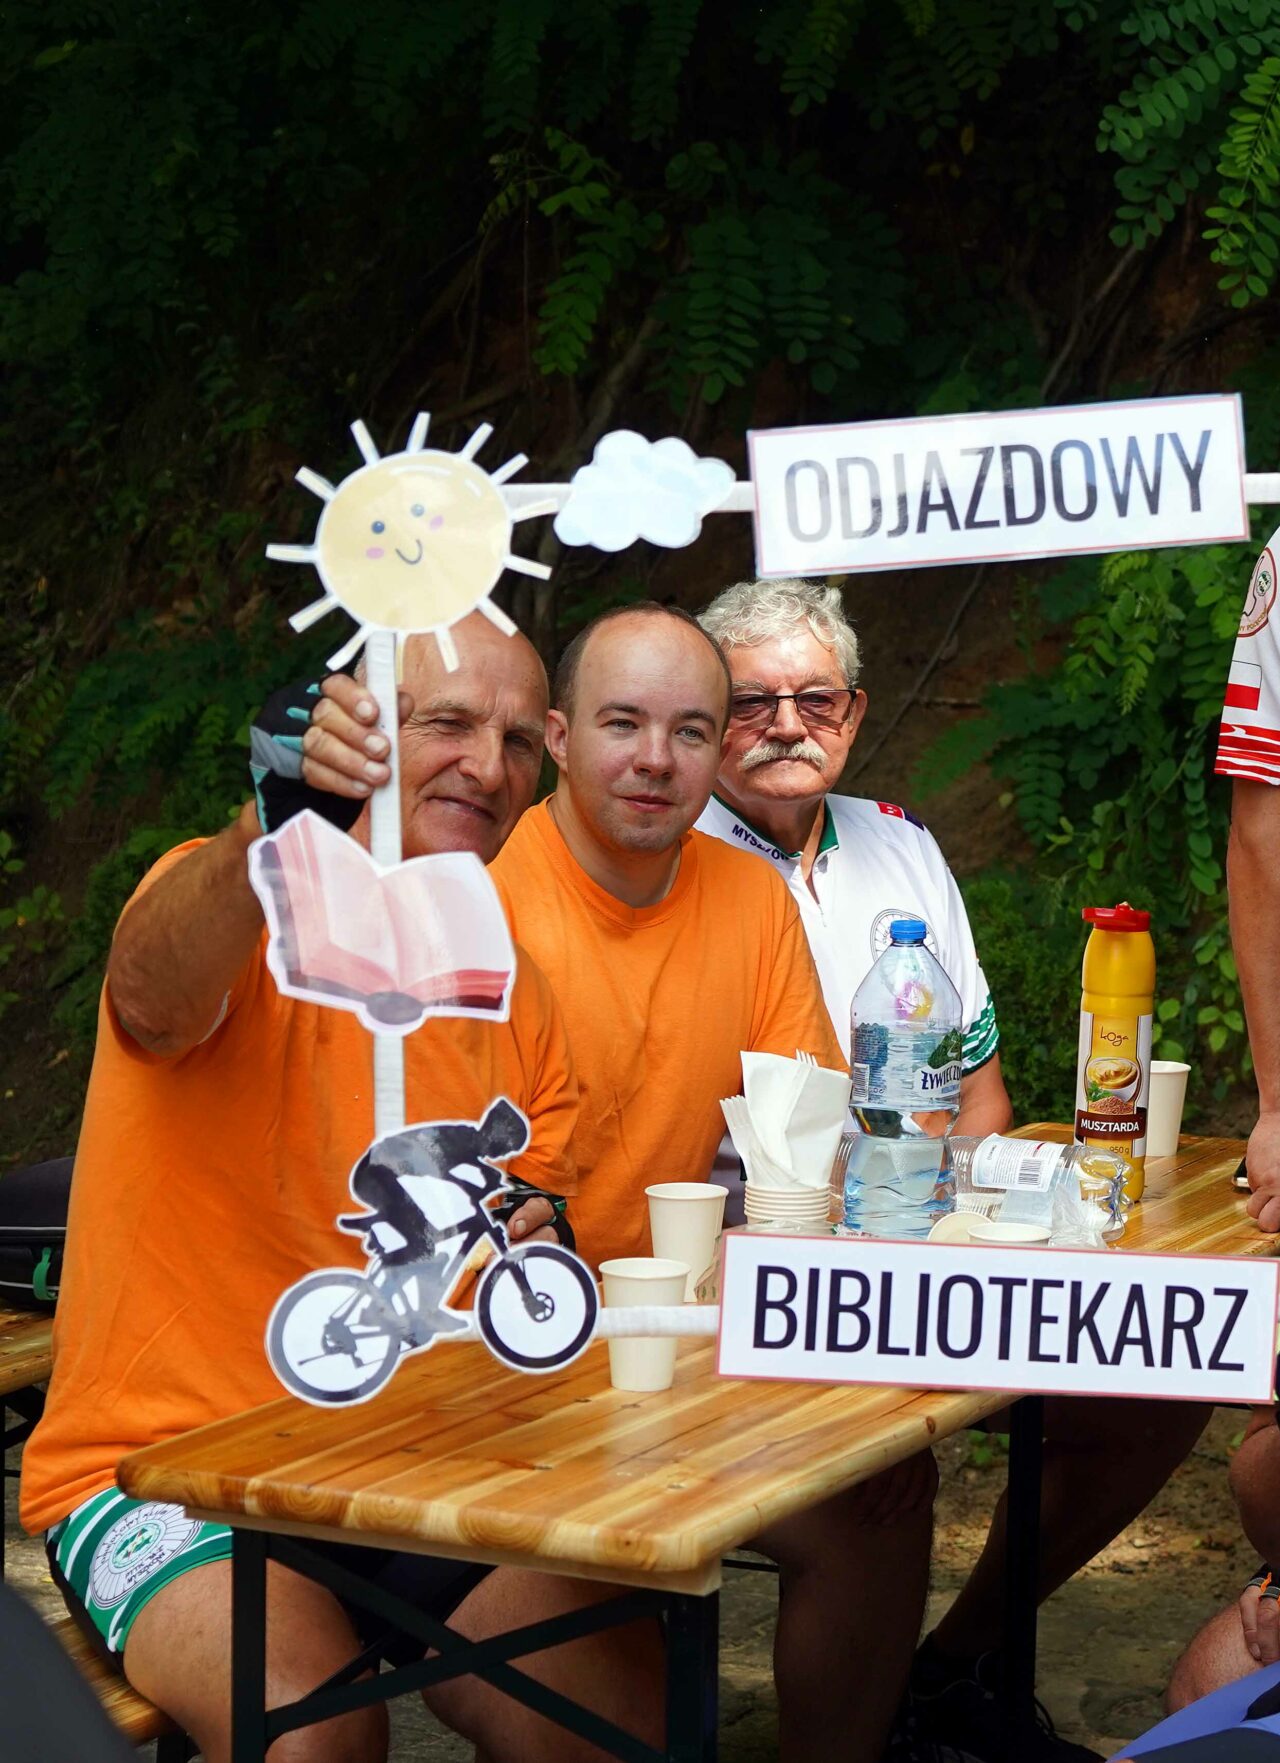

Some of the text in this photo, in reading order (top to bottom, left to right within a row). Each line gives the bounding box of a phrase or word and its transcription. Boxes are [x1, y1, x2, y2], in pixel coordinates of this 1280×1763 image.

[783, 429, 1213, 544] ODJAZDOWY
[1081, 1118, 1139, 1132] MUSZTARDA
[752, 1264, 1250, 1372] BIBLIOTEKARZ
